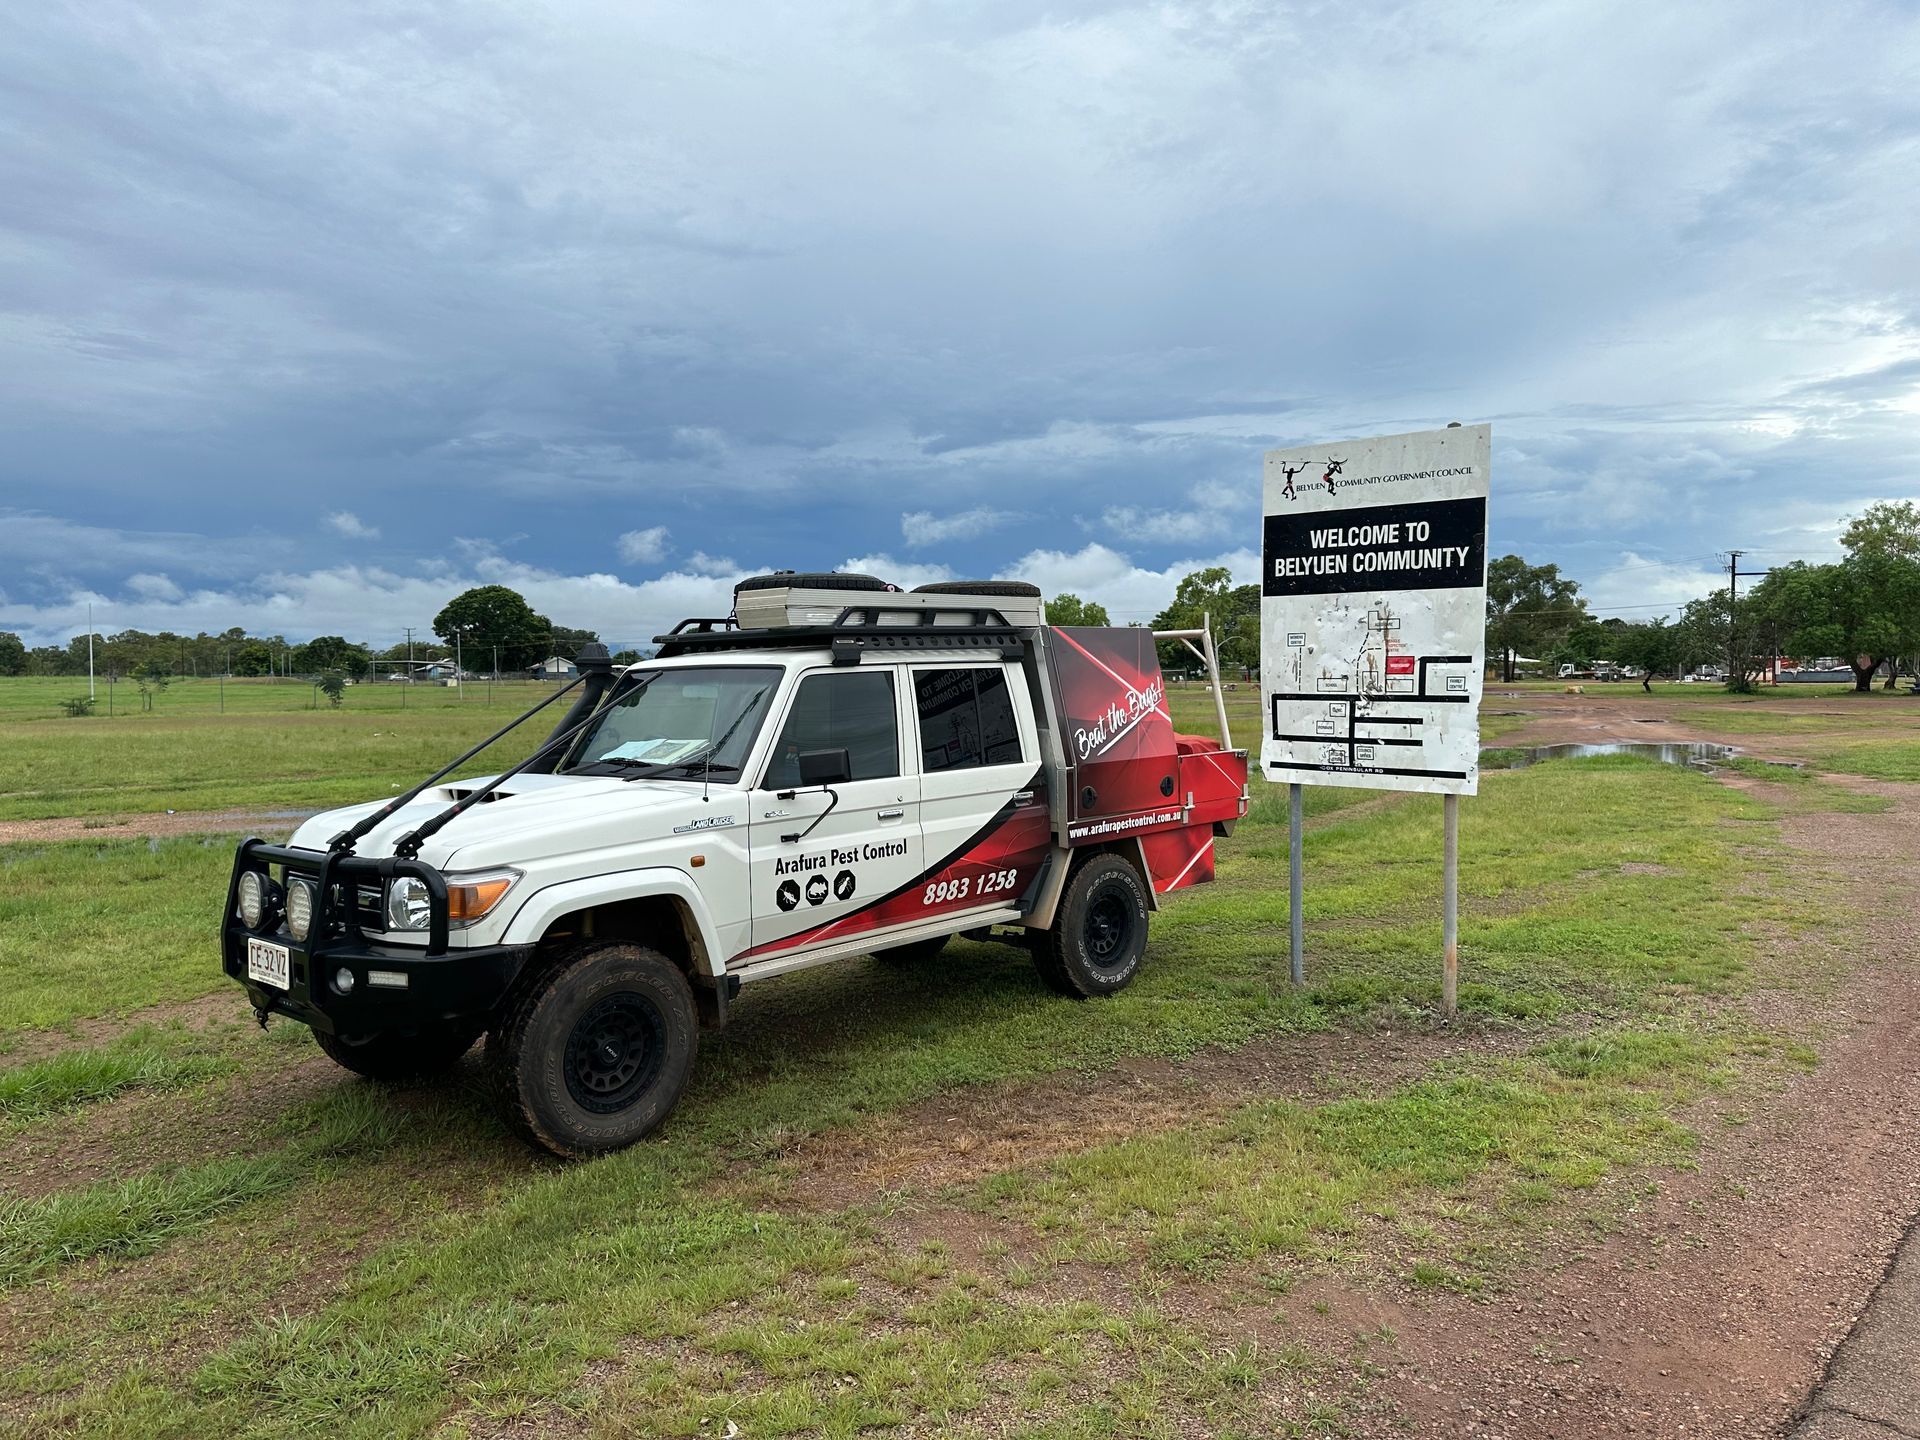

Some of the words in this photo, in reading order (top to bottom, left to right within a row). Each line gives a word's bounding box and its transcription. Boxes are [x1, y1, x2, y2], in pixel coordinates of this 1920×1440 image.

[1296, 483, 1326, 492] BELYUEN
[1335, 476, 1381, 488] COMMUNITY
[1383, 471, 1435, 482] GOVERNMENT
[1436, 466, 1472, 477] COUNCIL
[1310, 523, 1399, 549] WELCOME
[1404, 521, 1430, 542] TO
[1275, 554, 1347, 577] BELYUEN
[1352, 546, 1470, 573] COMMUNITY
[1075, 715, 1107, 760] Beat
[1107, 702, 1127, 734] the
[1125, 676, 1162, 721] Bugs!
[1069, 810, 1181, 839] www.arafurapestcontrol.com.au
[775, 854, 827, 876] Arafura
[831, 848, 859, 866] Pest
[862, 838, 907, 859] Control
[923, 877, 969, 905] 8983
[975, 868, 1017, 895] 1258
[264, 949, 274, 972] 32
[585, 971, 676, 1001] DUELER
